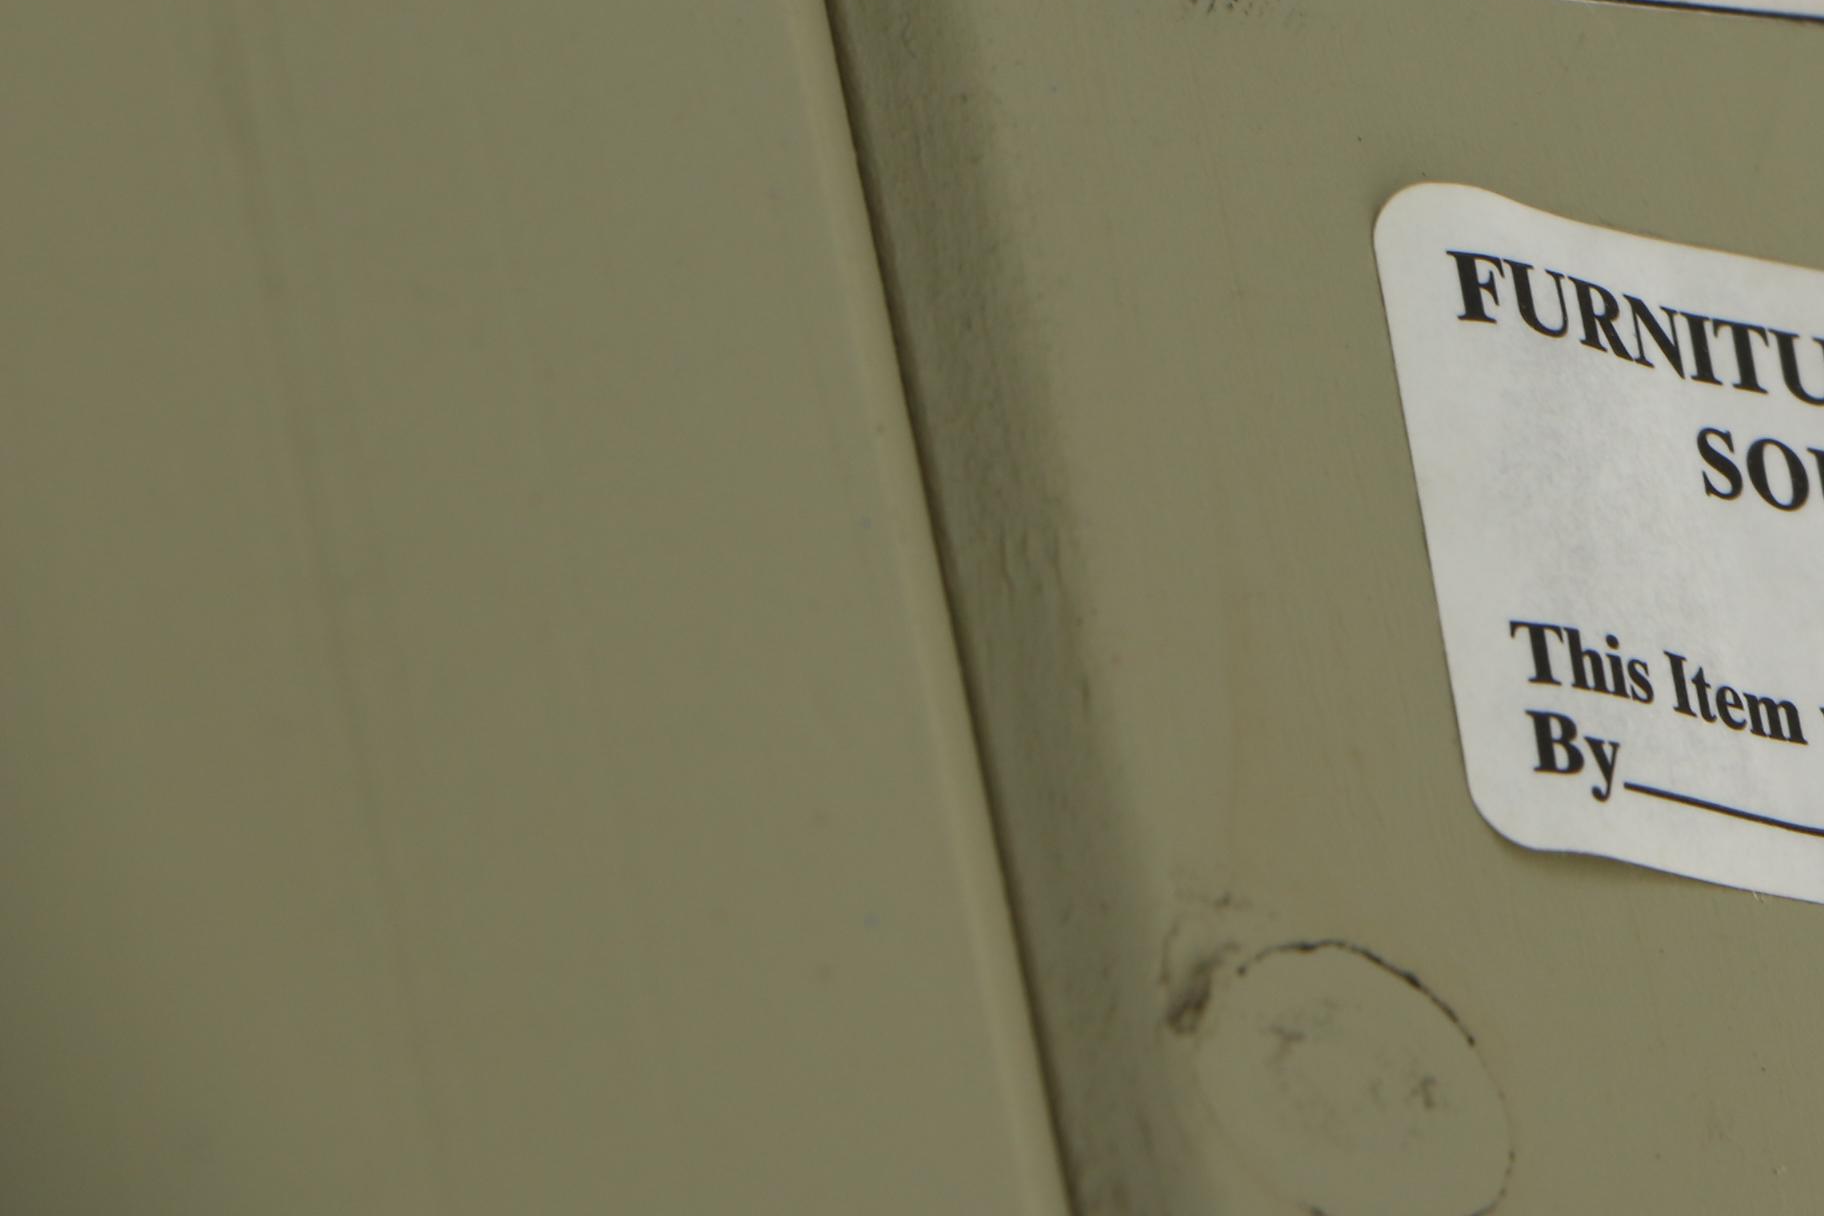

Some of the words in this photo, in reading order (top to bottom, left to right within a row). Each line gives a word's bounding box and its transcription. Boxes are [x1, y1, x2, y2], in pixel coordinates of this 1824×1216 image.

[1509, 619, 1655, 704] This
[1664, 650, 1807, 746] Item
[1524, 710, 1622, 801] By
